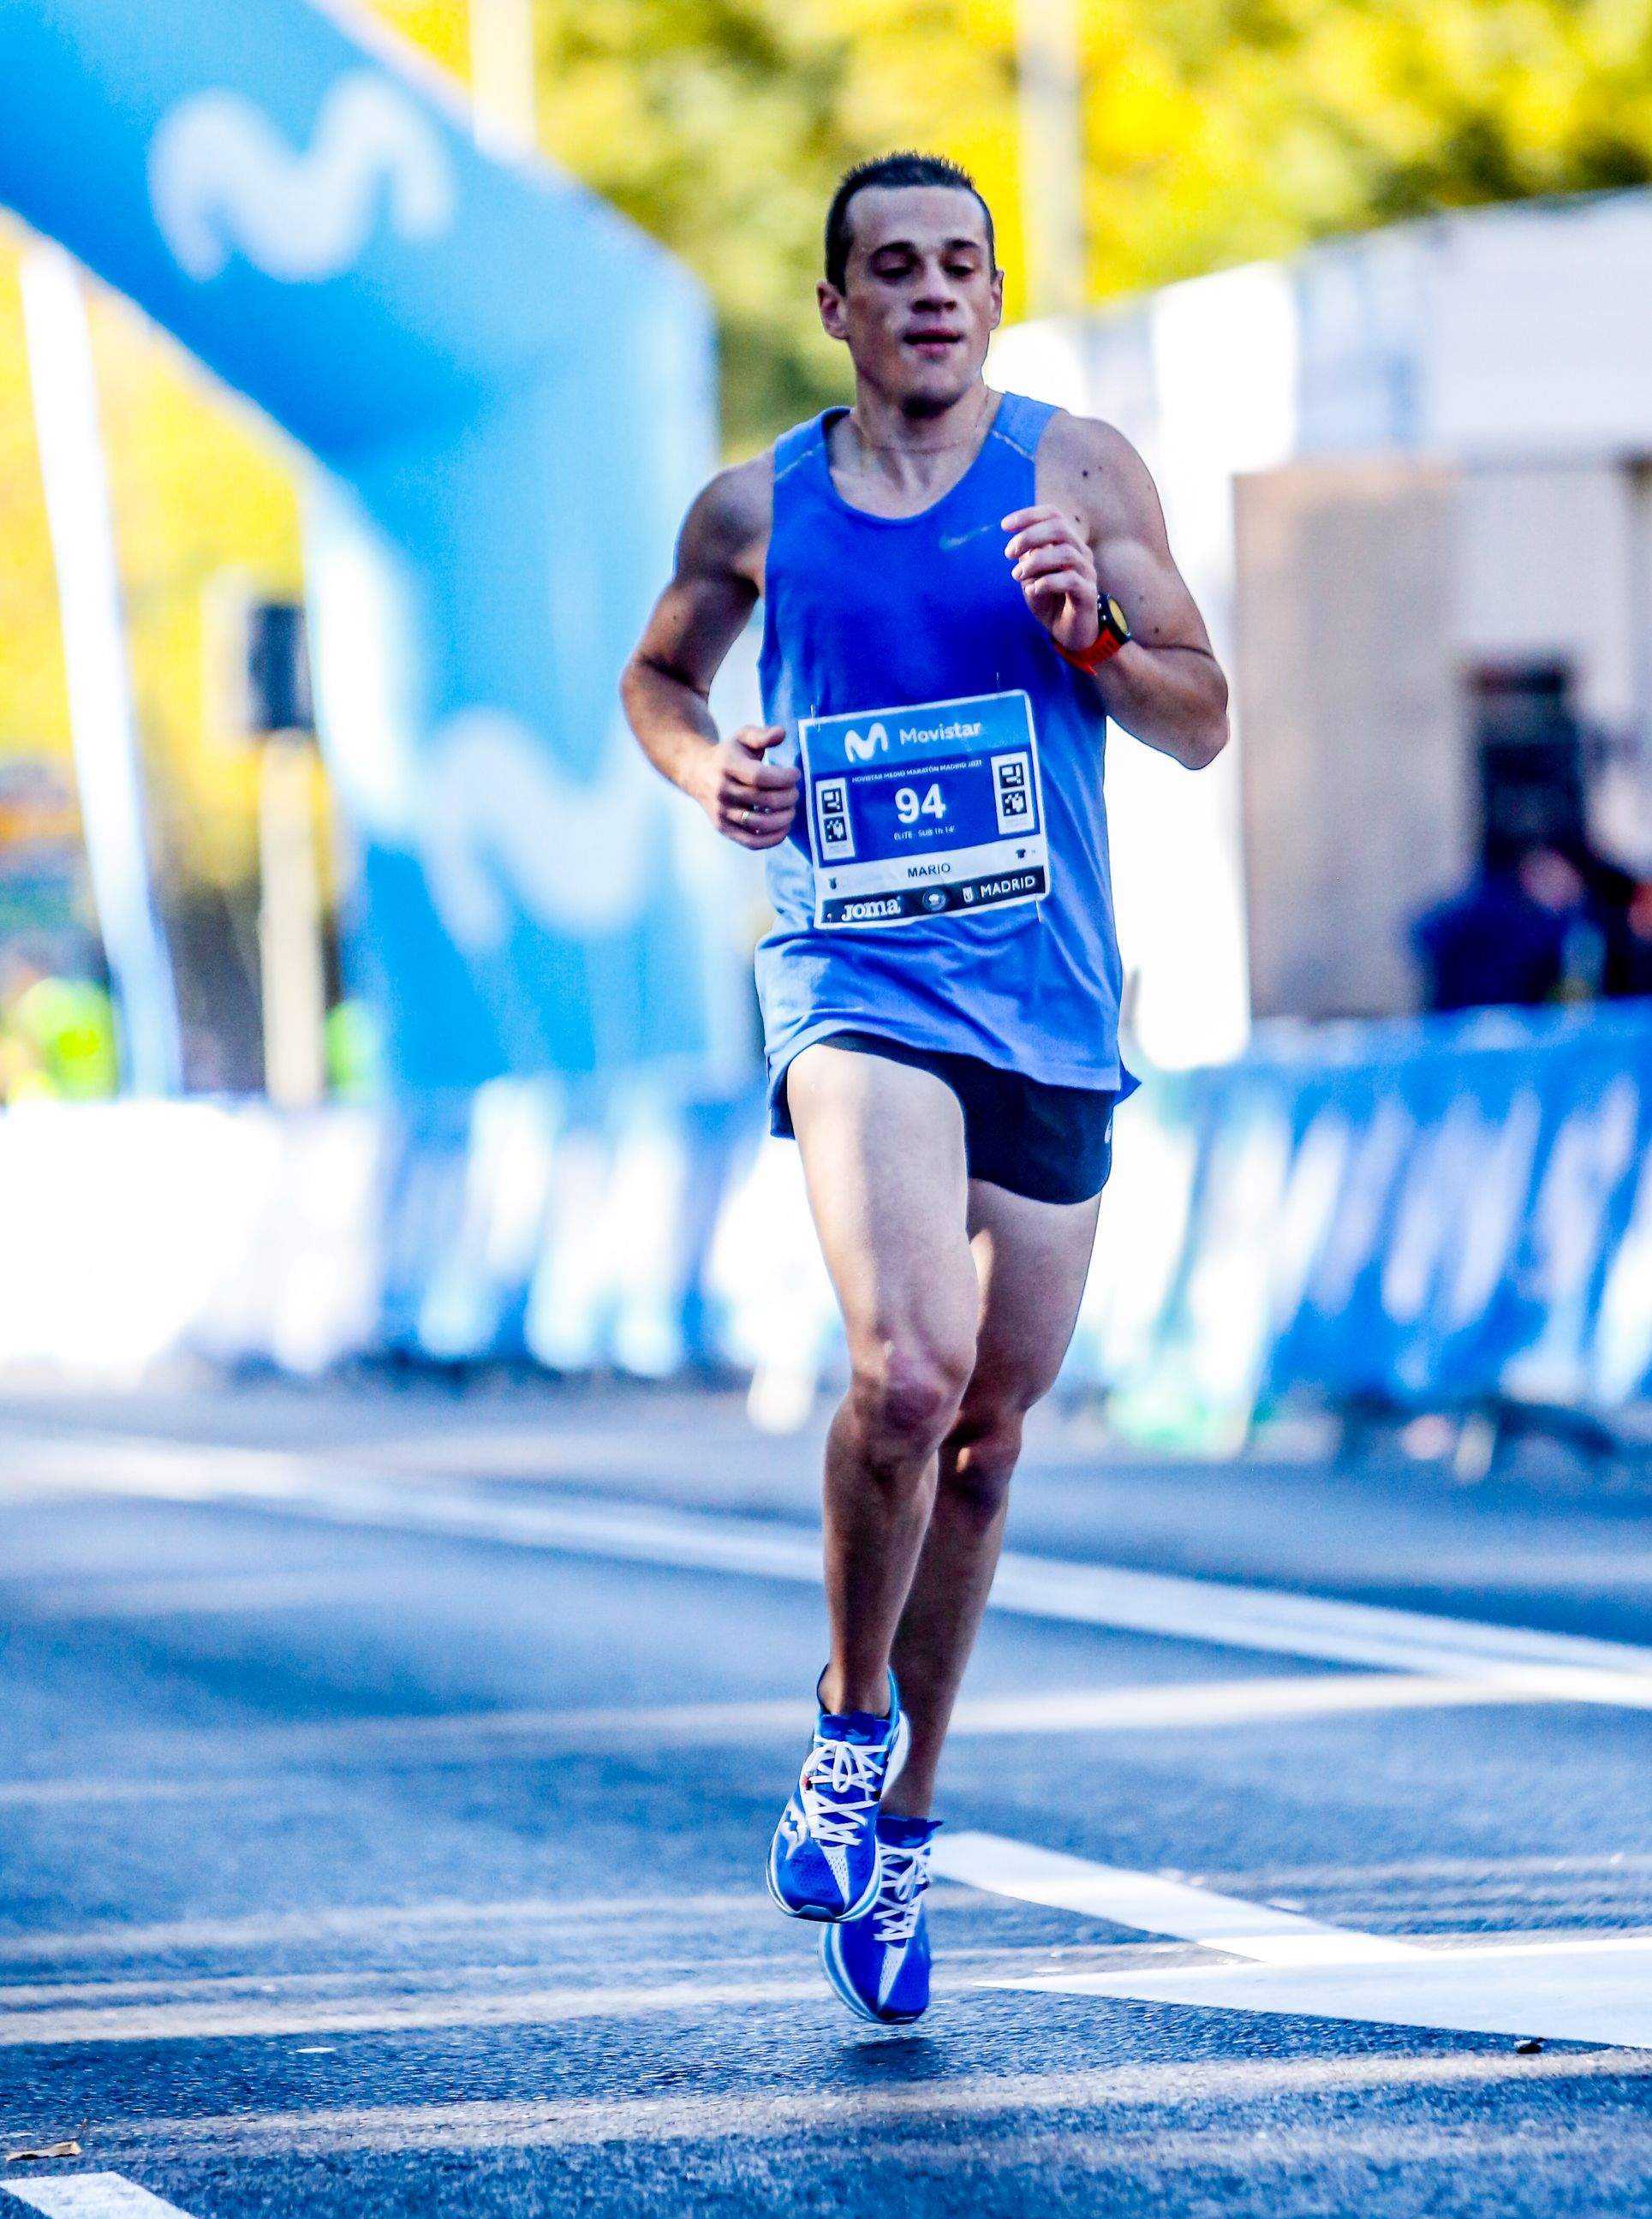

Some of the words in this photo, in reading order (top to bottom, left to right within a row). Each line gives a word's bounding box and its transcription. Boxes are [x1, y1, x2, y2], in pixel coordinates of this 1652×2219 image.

[899, 721, 981, 745] Movistar
[939, 761, 967, 771] MADRID
[895, 783, 946, 824] 94
[907, 862, 951, 878] MARIO
[980, 875, 1035, 898] MADRID
